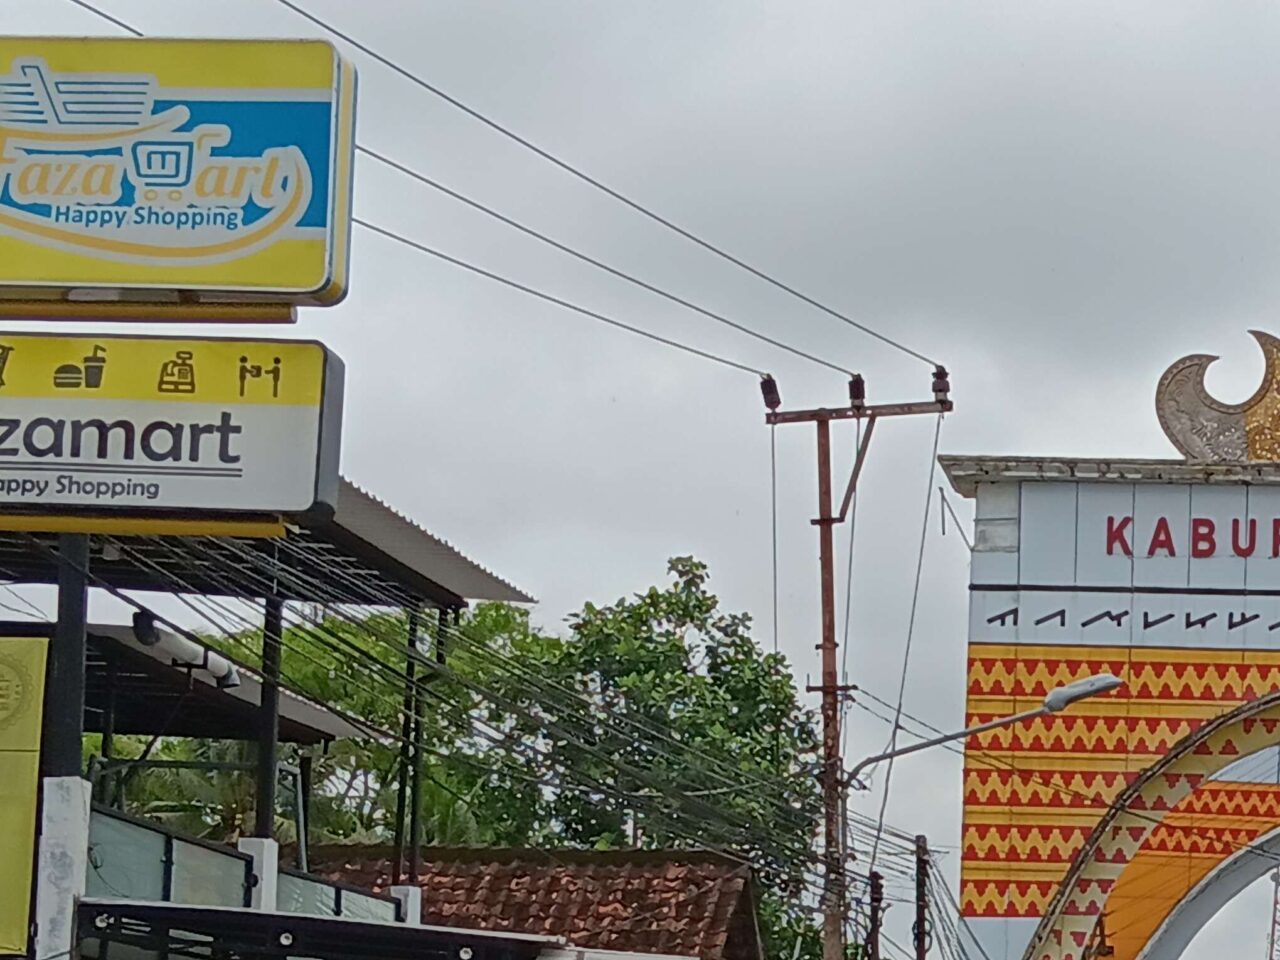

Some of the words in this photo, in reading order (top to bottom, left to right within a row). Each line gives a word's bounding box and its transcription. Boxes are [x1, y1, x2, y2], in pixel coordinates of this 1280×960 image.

[55, 205, 127, 228] Happy
[134, 206, 239, 230] Shopping
[56, 475, 160, 499] Shopping
